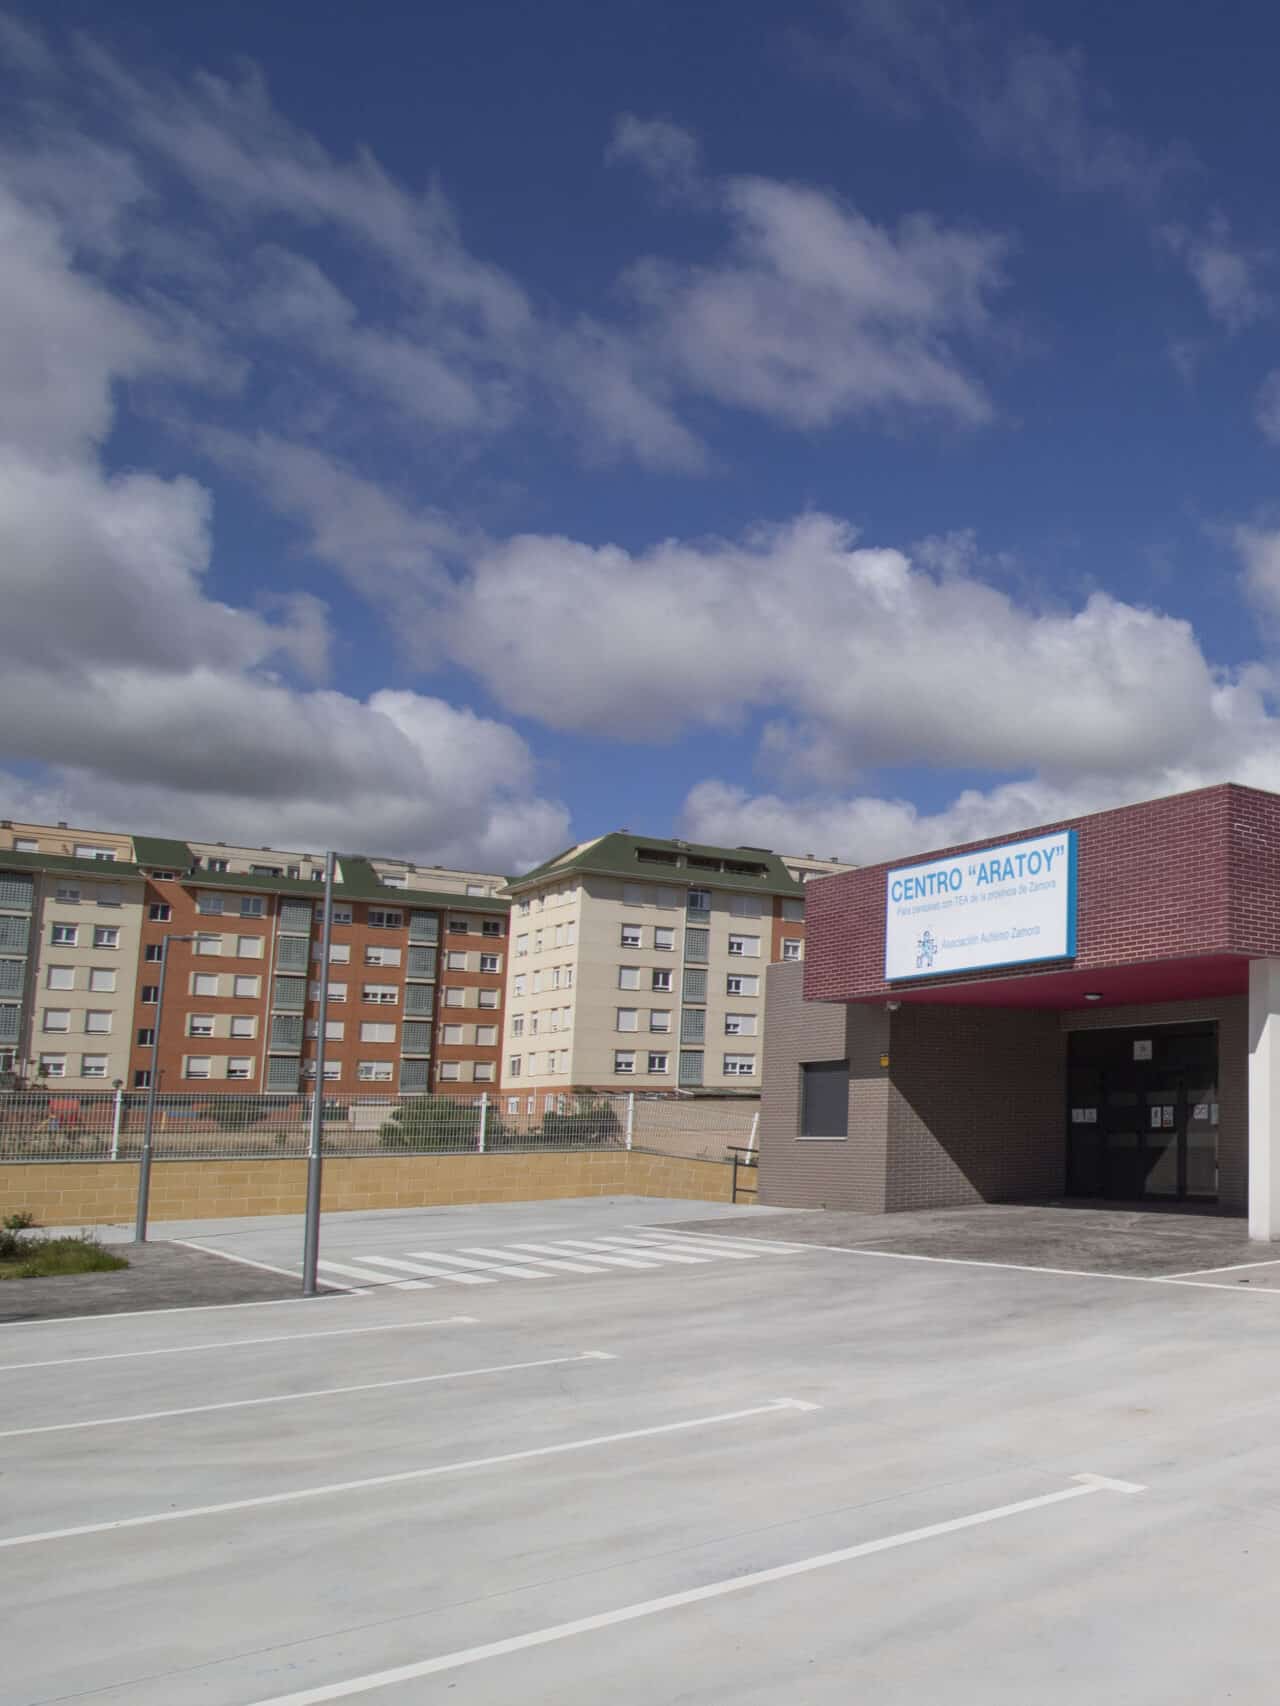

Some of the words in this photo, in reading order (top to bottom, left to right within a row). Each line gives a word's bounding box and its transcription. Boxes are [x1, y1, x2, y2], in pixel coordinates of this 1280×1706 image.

[891, 868, 963, 902] CENTRO
[955, 895, 969, 906] TEA
[1029, 879, 1056, 893] Zamora
[1011, 925, 1041, 940] Zamora
